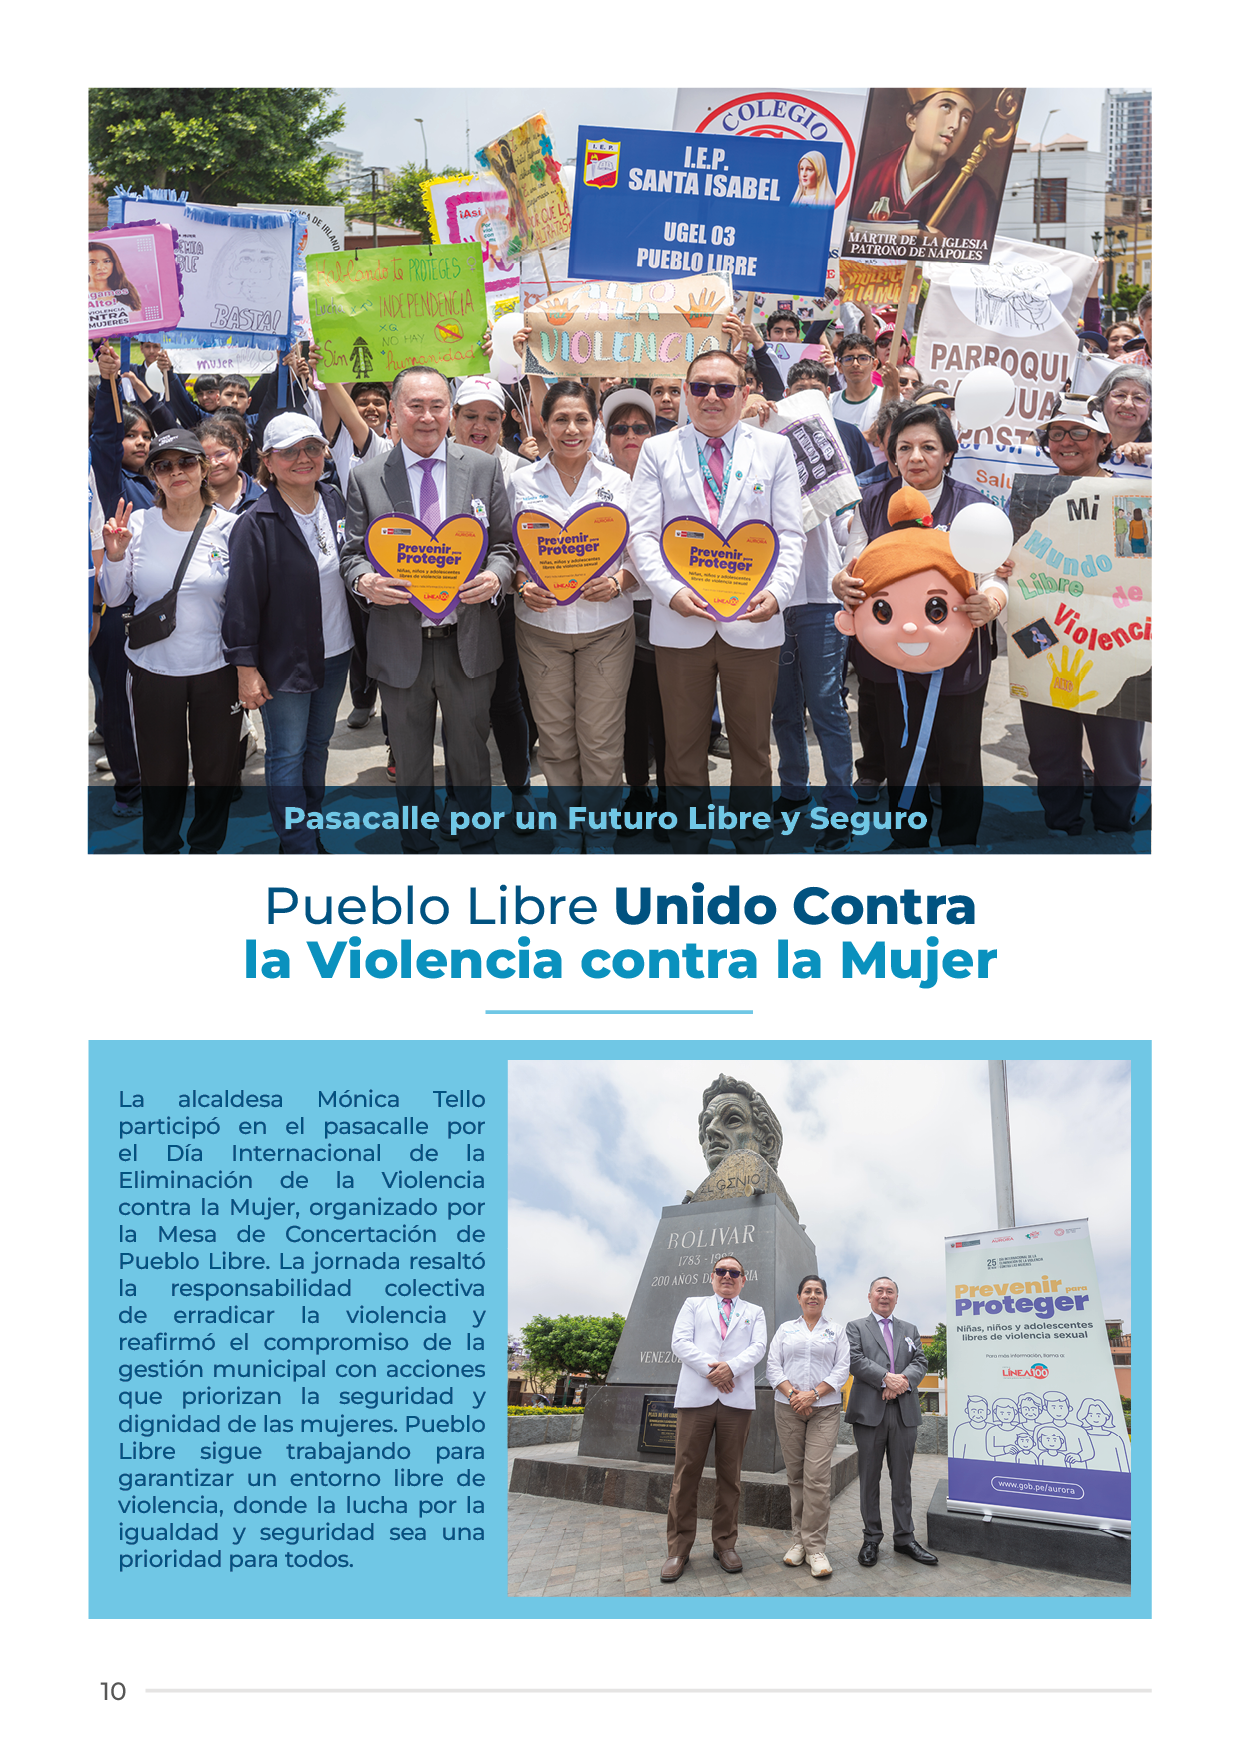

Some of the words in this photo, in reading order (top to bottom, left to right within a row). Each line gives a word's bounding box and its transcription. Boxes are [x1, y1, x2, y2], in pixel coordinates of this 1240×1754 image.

[722, 99, 828, 141] COLEGIO
[683, 145, 729, 171] I.E.P.
[628, 167, 700, 196] SANTA
[704, 173, 781, 202] ISABEL
[311, 215, 324, 228] DE
[321, 223, 341, 252] IRLAND
[663, 221, 708, 245] UGEL
[711, 225, 736, 247] 03
[848, 231, 898, 246] MÁRTIR
[900, 235, 917, 247] DE
[922, 236, 938, 248] LA
[942, 237, 988, 250] IGLESIA
[635, 247, 703, 273] PUEBLO
[707, 253, 758, 277] LIBRE
[850, 244, 907, 258] PATRONO
[909, 246, 926, 259] DE
[928, 246, 983, 261] NÁPOLES
[316, 259, 389, 287] Hablando
[391, 258, 404, 282] te
[409, 257, 461, 282] PROTEGES
[88, 288, 130, 300] gamos
[379, 288, 475, 319] INDEPENDENCIA
[572, 281, 677, 303] ALTO
[315, 296, 346, 317] Lucha
[549, 310, 567, 319] Paz
[584, 300, 610, 322] A
[89, 318, 130, 329] MUJERES
[210, 303, 282, 335] BASTA!
[382, 333, 399, 348] NO
[404, 333, 425, 344] HAY
[540, 328, 721, 365] VIOLENCIA
[324, 339, 349, 368] Sin
[386, 345, 476, 372] humanidad
[931, 343, 1069, 384] PARROQUI
[976, 469, 1012, 490] Salu
[1066, 494, 1101, 522] Mi
[397, 543, 452, 555] Prevenir
[537, 532, 589, 547] Prevenir
[538, 542, 600, 557] Proteger
[397, 552, 462, 569] Proteger
[689, 555, 753, 574] Proteger
[690, 546, 743, 560] Prevenir
[1023, 529, 1113, 578] Mundo
[1017, 572, 1084, 600] Libre
[1112, 585, 1144, 609] de
[1053, 602, 1152, 652] Violenci
[1053, 676, 1074, 693] ALTO
[267, 885, 450, 925] Pueblo
[469, 885, 598, 925] Libre
[616, 882, 777, 925] Unido
[793, 886, 976, 926] Contra
[245, 939, 291, 979] la
[306, 936, 563, 979] Violencia
[580, 943, 758, 980] contra
[777, 939, 822, 979] la
[842, 936, 998, 990] Mujer
[119, 1090, 145, 1108] La
[178, 1089, 283, 1109] alcaldesa
[318, 1088, 400, 1109] Mónica
[432, 1089, 486, 1109] Tello
[118, 1143, 138, 1163] el
[167, 1143, 203, 1162] Día
[232, 1142, 381, 1163] Internacional
[409, 1143, 439, 1163] de
[466, 1143, 485, 1163] la
[119, 1169, 253, 1190] Eliminación
[279, 1170, 309, 1190] de
[336, 1170, 355, 1189] la
[380, 1169, 485, 1190] Violencia
[716, 1173, 761, 1191] GENIO
[119, 1224, 137, 1243] la
[158, 1225, 217, 1244] Mesa
[236, 1224, 266, 1244] de
[285, 1223, 437, 1244] Concertación
[456, 1224, 486, 1244] de
[667, 1224, 756, 1250] BOLIVAR
[678, 1255, 701, 1267] 1783
[987, 1258, 997, 1268] 25
[119, 1278, 137, 1297] la
[171, 1277, 352, 1302] responsabilidad
[384, 1277, 485, 1298] colectiva
[651, 1276, 670, 1287] 200
[671, 1272, 699, 1286] AÑOS
[954, 1274, 1063, 1299] Prevenir
[1065, 1285, 1088, 1294] para
[118, 1305, 148, 1324] de
[173, 1304, 276, 1325] erradicar
[301, 1305, 320, 1325] la
[345, 1304, 447, 1325] violencia
[471, 1309, 487, 1329] y
[955, 1294, 1090, 1320] Proteger
[956, 1324, 985, 1334] Niñas,
[986, 1322, 1013, 1332] niños
[1015, 1324, 1021, 1332] y
[1023, 1321, 1094, 1331] adolescentes
[962, 1333, 988, 1342] libres
[990, 1333, 1003, 1341] de
[1005, 1331, 1051, 1340] violencia
[1053, 1330, 1088, 1340] sexual
[118, 1358, 204, 1383] gestión
[213, 1358, 326, 1383] municipal
[335, 1363, 377, 1379] con
[386, 1358, 486, 1379] acciones
[1002, 1367, 1034, 1378] LÍNEA
[1032, 1368, 1049, 1378] 100
[118, 1390, 163, 1410] que
[182, 1385, 282, 1410] priorizan
[301, 1386, 320, 1406] la
[338, 1385, 454, 1410] seguridad
[471, 1390, 487, 1410] y
[119, 1440, 176, 1461] Libre
[199, 1440, 263, 1465] sigue
[285, 1440, 411, 1465] trabajando
[436, 1445, 485, 1465] para
[998, 1479, 1076, 1495] www.gob.pe/aurora
[117, 1494, 224, 1518] violencia,
[233, 1495, 308, 1515] donde
[317, 1495, 336, 1515] la
[346, 1495, 408, 1515] lucha
[418, 1499, 458, 1519] por
[466, 1495, 485, 1515] la
[119, 1548, 222, 1573] prioridad
[229, 1553, 278, 1573] para
[284, 1549, 354, 1569] todos.
[100, 1681, 127, 1701] 10
